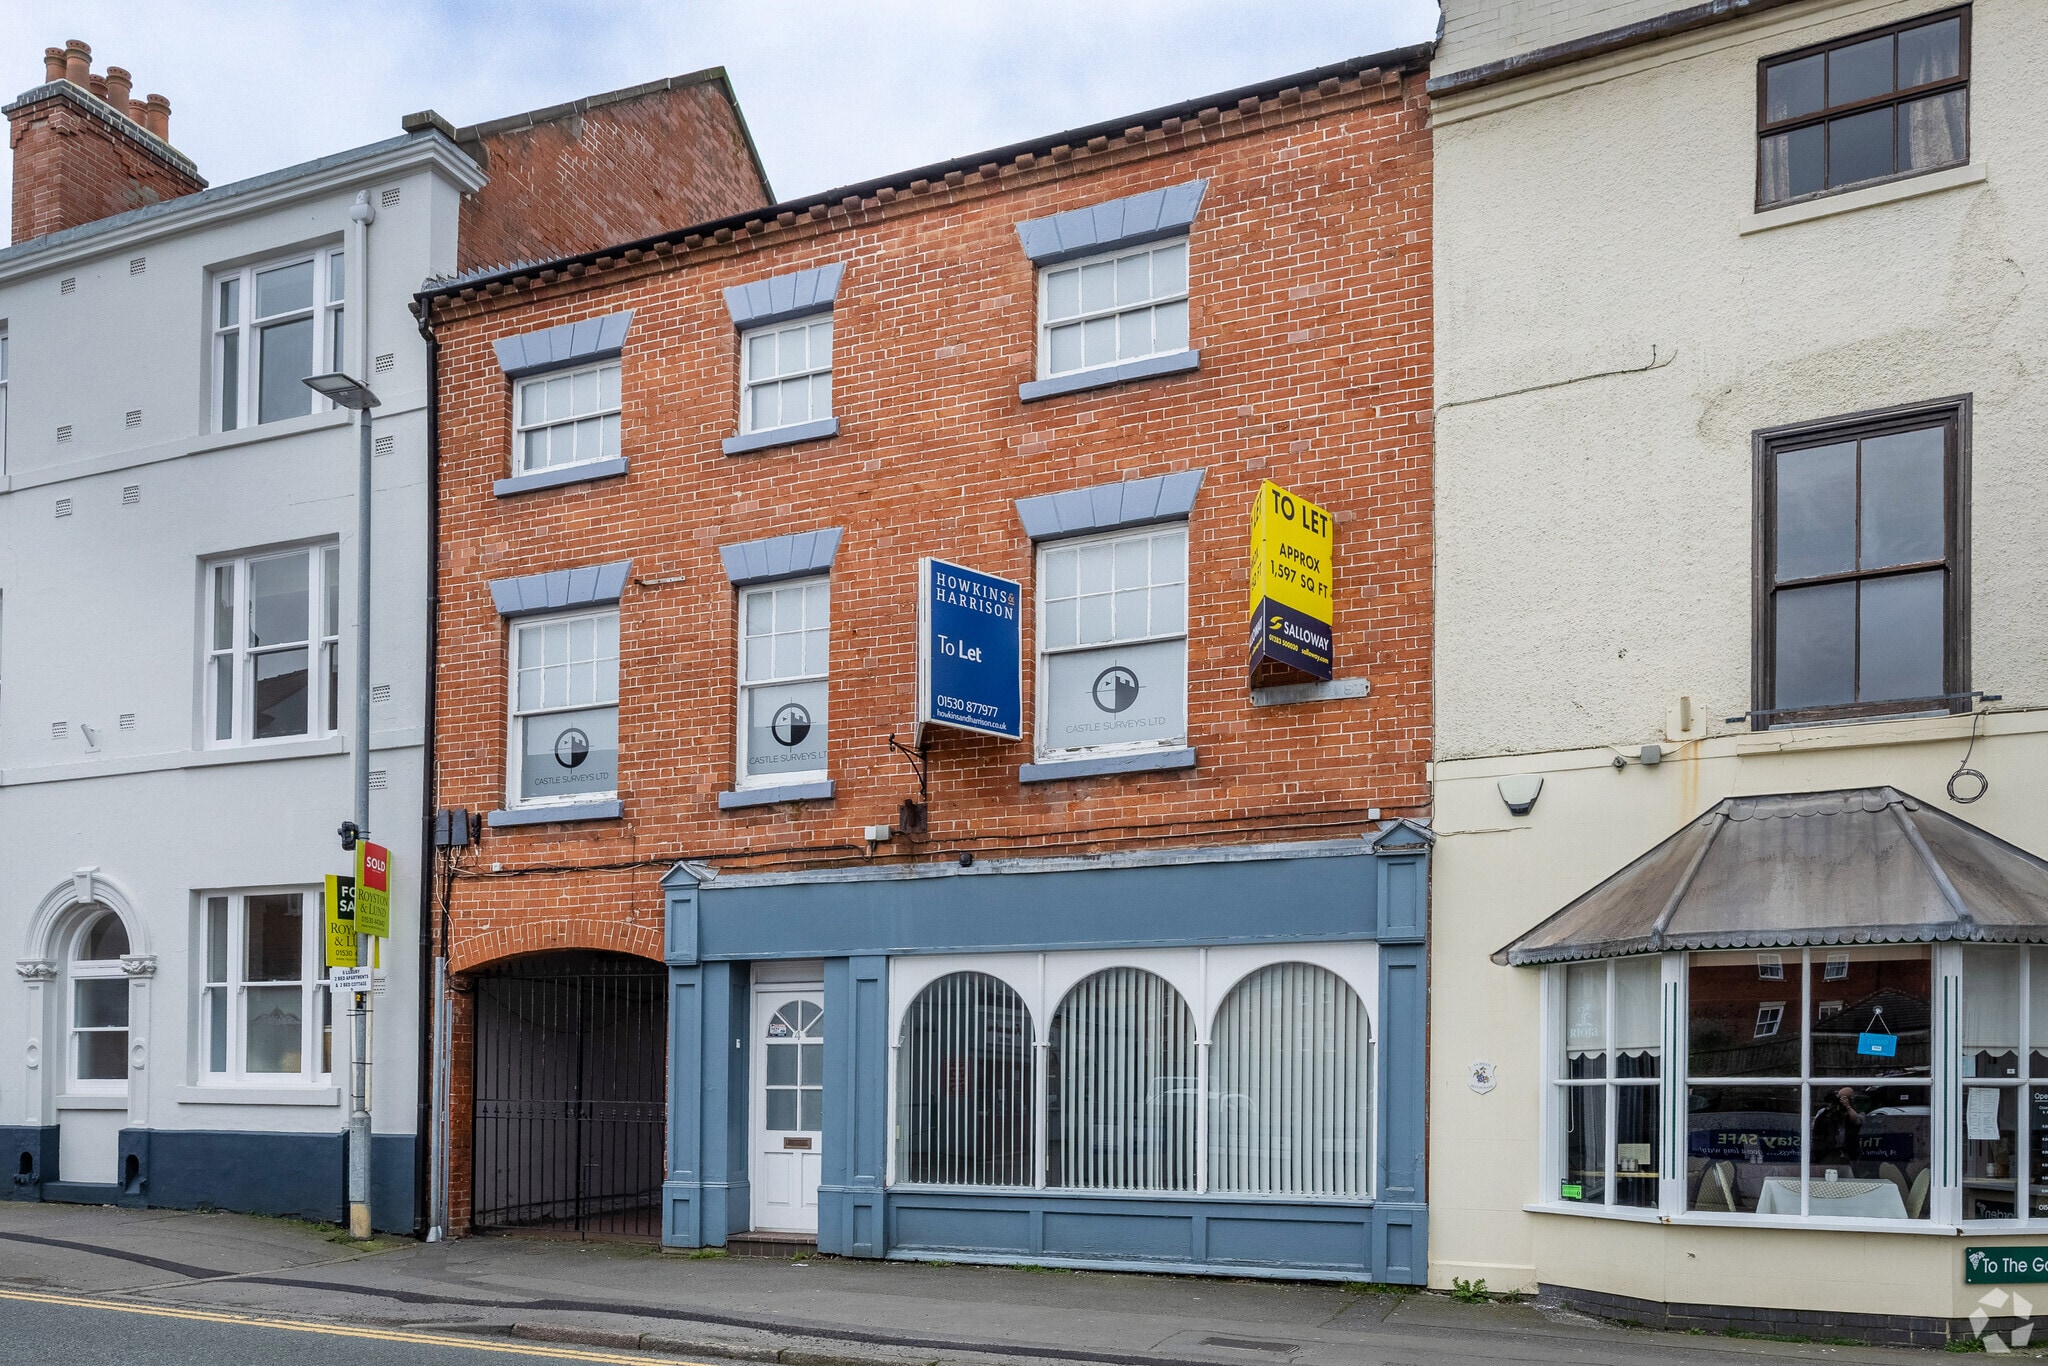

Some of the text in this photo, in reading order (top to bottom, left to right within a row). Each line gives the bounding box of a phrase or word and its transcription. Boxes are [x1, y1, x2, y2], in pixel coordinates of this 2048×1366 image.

[1272, 489, 1327, 538] TO LET
[1279, 542, 1320, 573] APPROX
[1270, 560, 1328, 599] 1,597 SQ FT
[936, 587, 1013, 620] HARRISON
[1283, 621, 1329, 651] SALLOWAY
[938, 634, 982, 663] To Let
[1301, 648, 1329, 664] salloway.com
[937, 694, 998, 718] 01530 877977
[937, 708, 1007, 730] howkinsandharrison.co.uk
[1066, 717, 1165, 733] CASTLE SURVEYS LTD
[749, 755, 778, 764] CASTLE
[781, 752, 816, 762] SURVEYS
[534, 772, 609, 786] CASTLE SURVEYS LTD
[366, 856, 386, 872] SOLD
[341, 886, 355, 898] FO
[358, 888, 388, 906] ROYSTON
[339, 899, 355, 912] SA
[360, 903, 387, 918] & LUND
[334, 935, 358, 948] & LU
[335, 949, 353, 957] 01530
[1982, 1258, 1998, 1273] To
[2002, 1257, 2028, 1273] The
